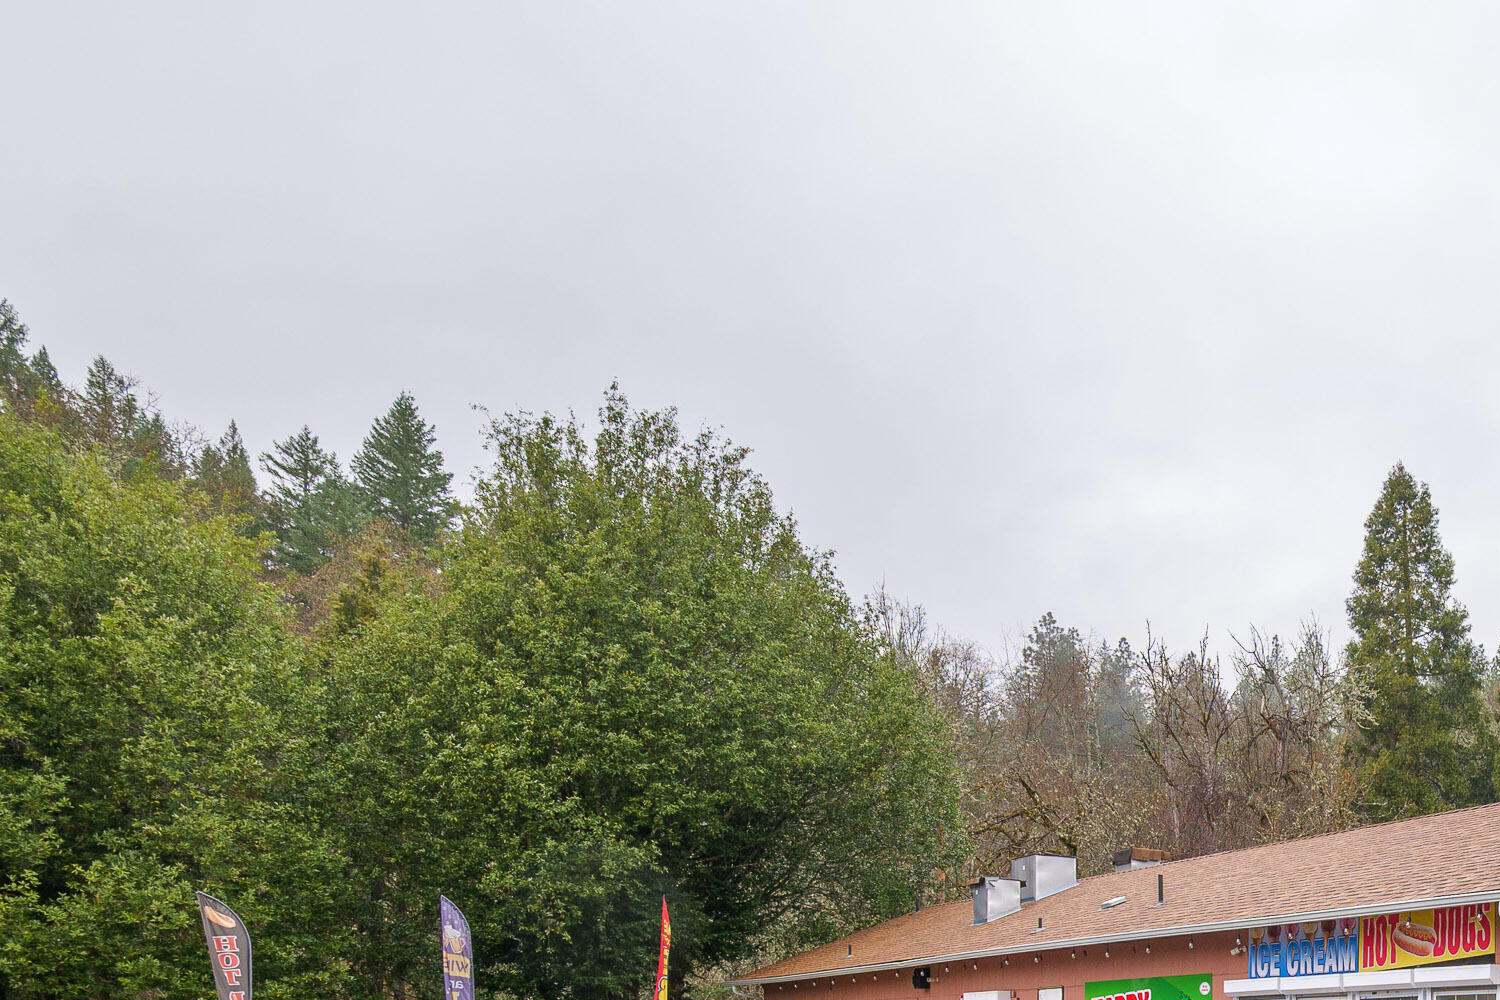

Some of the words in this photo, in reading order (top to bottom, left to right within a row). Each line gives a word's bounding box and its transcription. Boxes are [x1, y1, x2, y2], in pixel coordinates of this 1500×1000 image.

[1250, 942, 1280, 978] ICE
[1286, 935, 1356, 977] CREAM
[1362, 913, 1399, 969] HOT
[1433, 902, 1491, 958] DOGS
